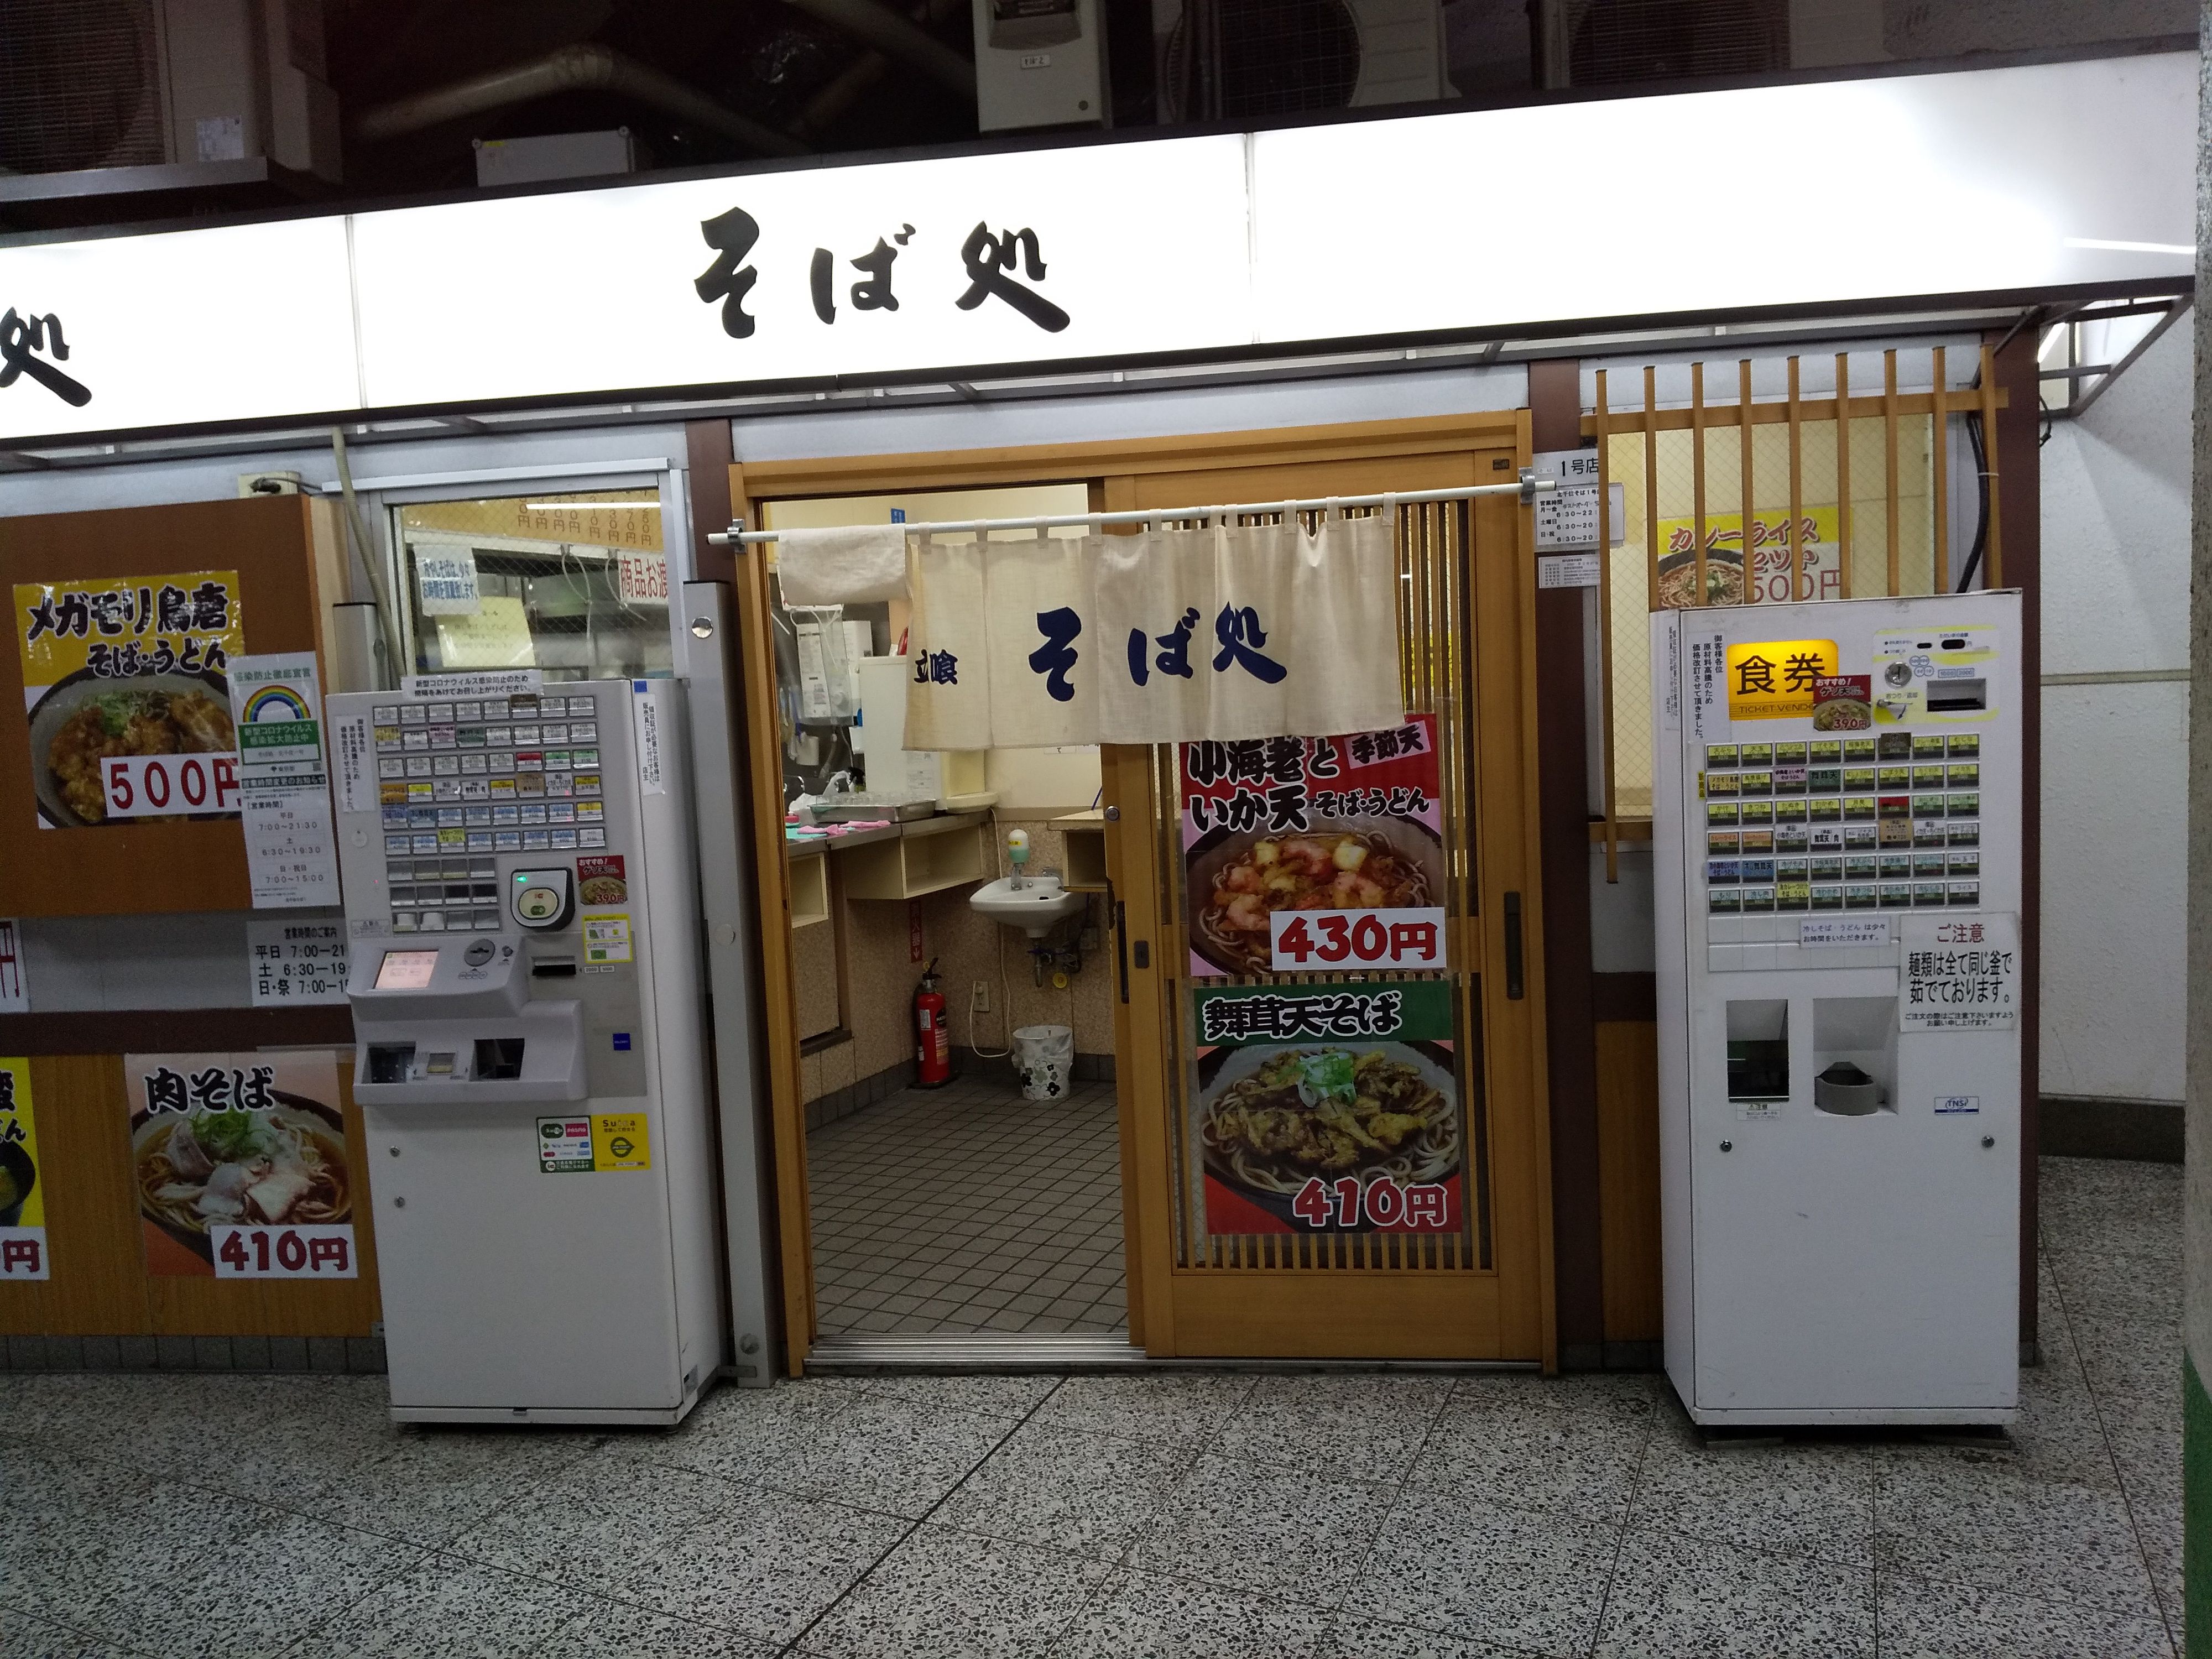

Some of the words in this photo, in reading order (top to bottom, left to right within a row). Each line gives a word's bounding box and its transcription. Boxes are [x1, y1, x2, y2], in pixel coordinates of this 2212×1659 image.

[694, 206, 1070, 338] そば処
[1562, 457, 1598, 477] 1号店
[87, 636, 227, 677] そば・うどん
[1029, 602, 1287, 702] そば処
[1714, 635, 1723, 673] 御客様各位
[1693, 644, 1703, 739] 価格改訂させて頂きました。
[1703, 643, 1713, 705] 原材料高騰のため
[1735, 653, 1825, 695] 食券
[1739, 705, 1773, 713] TICKET
[1833, 719, 1867, 729] 390円
[1352, 724, 1426, 764] 季節天
[1190, 784, 1308, 832] いか天
[1314, 787, 1430, 818] そば・うどん
[597, 894, 624, 904] 390円
[255, 945, 280, 959] 平日
[1278, 914, 1438, 963] 430円
[1803, 933, 1879, 942] お時間をいただきます。
[1937, 923, 1984, 943] ご注意
[259, 963, 272, 977] 土
[1908, 951, 2012, 977] 麺類は全て同じ釜で
[1910, 977, 2010, 1004] 茹でております。
[1203, 991, 1402, 1041] 舞茸天そば
[1906, 1011, 2014, 1020] ご注文の際はご注意下さいますよう
[144, 1066, 278, 1114] 肉そば
[1293, 1177, 1447, 1227] 410円
[220, 1230, 349, 1271] 410円
